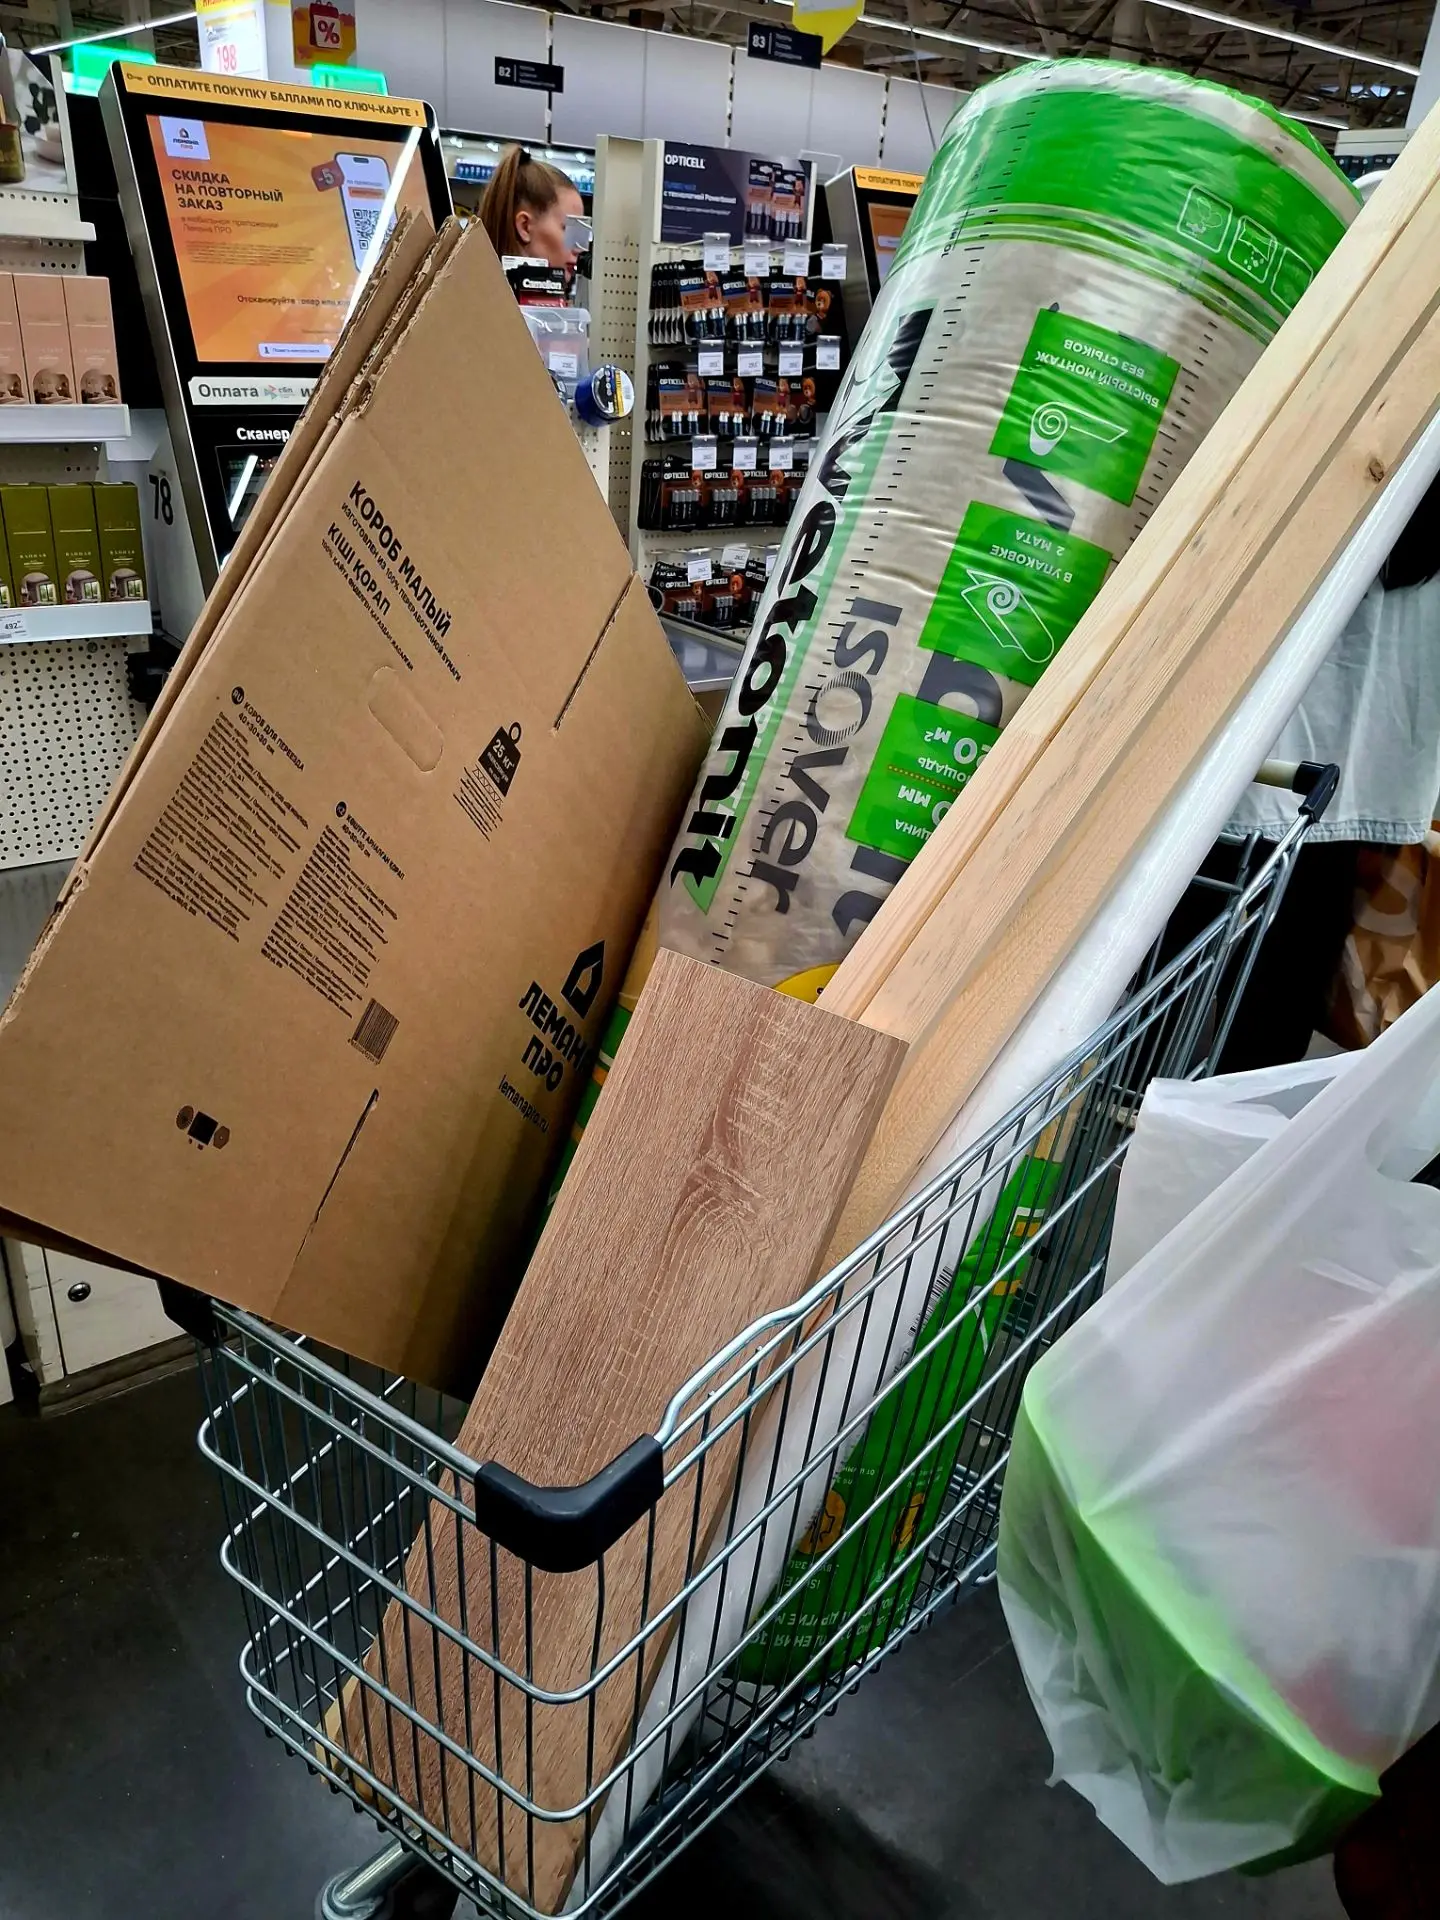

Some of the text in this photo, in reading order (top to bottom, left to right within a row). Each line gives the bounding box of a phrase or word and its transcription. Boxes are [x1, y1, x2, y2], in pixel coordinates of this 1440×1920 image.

[216, 44, 237, 72] 198
[752, 35, 766, 48] 83
[498, 66, 511, 78] 82
[147, 75, 411, 117] ОПЛАТИТЕ ПОКУПКУ БАЛЛАМИ ПО КЛЮЧ-КАРТЕ
[172, 169, 230, 185] СКИДКА
[665, 154, 705, 169] OPTICELL
[175, 183, 284, 203] НА ПОВТОРНЫЙ
[177, 197, 224, 211] ЗАКАЗ
[1063, 338, 1145, 379] БЕЗ СТЫКОВ
[198, 383, 259, 398] Оплата
[1035, 350, 1160, 408] БЫСТРЫЙ МОНТАЖ
[236, 427, 290, 442] Сканер
[148, 473, 174, 526] 78
[350, 480, 452, 638] КОРОБ МАЛЫЙ
[1015, 529, 1066, 556] 2 МАТА
[327, 522, 391, 616] КІШІ ҚОРАП
[990, 544, 1073, 583] В УПАКОВКЕ
[341, 502, 462, 683] ИЗГОТОВЛЕН ИЗ 100% ПЕРЕРАБОТАННОЙ БУМАГИ
[243, 701, 305, 772] КОРОБ ДЛЯ ПЕРЕЕЗДА
[492, 738, 506, 758] 25
[520, 1033, 564, 1092] ПРО
[498, 1073, 550, 1134] lemanapro.ru
